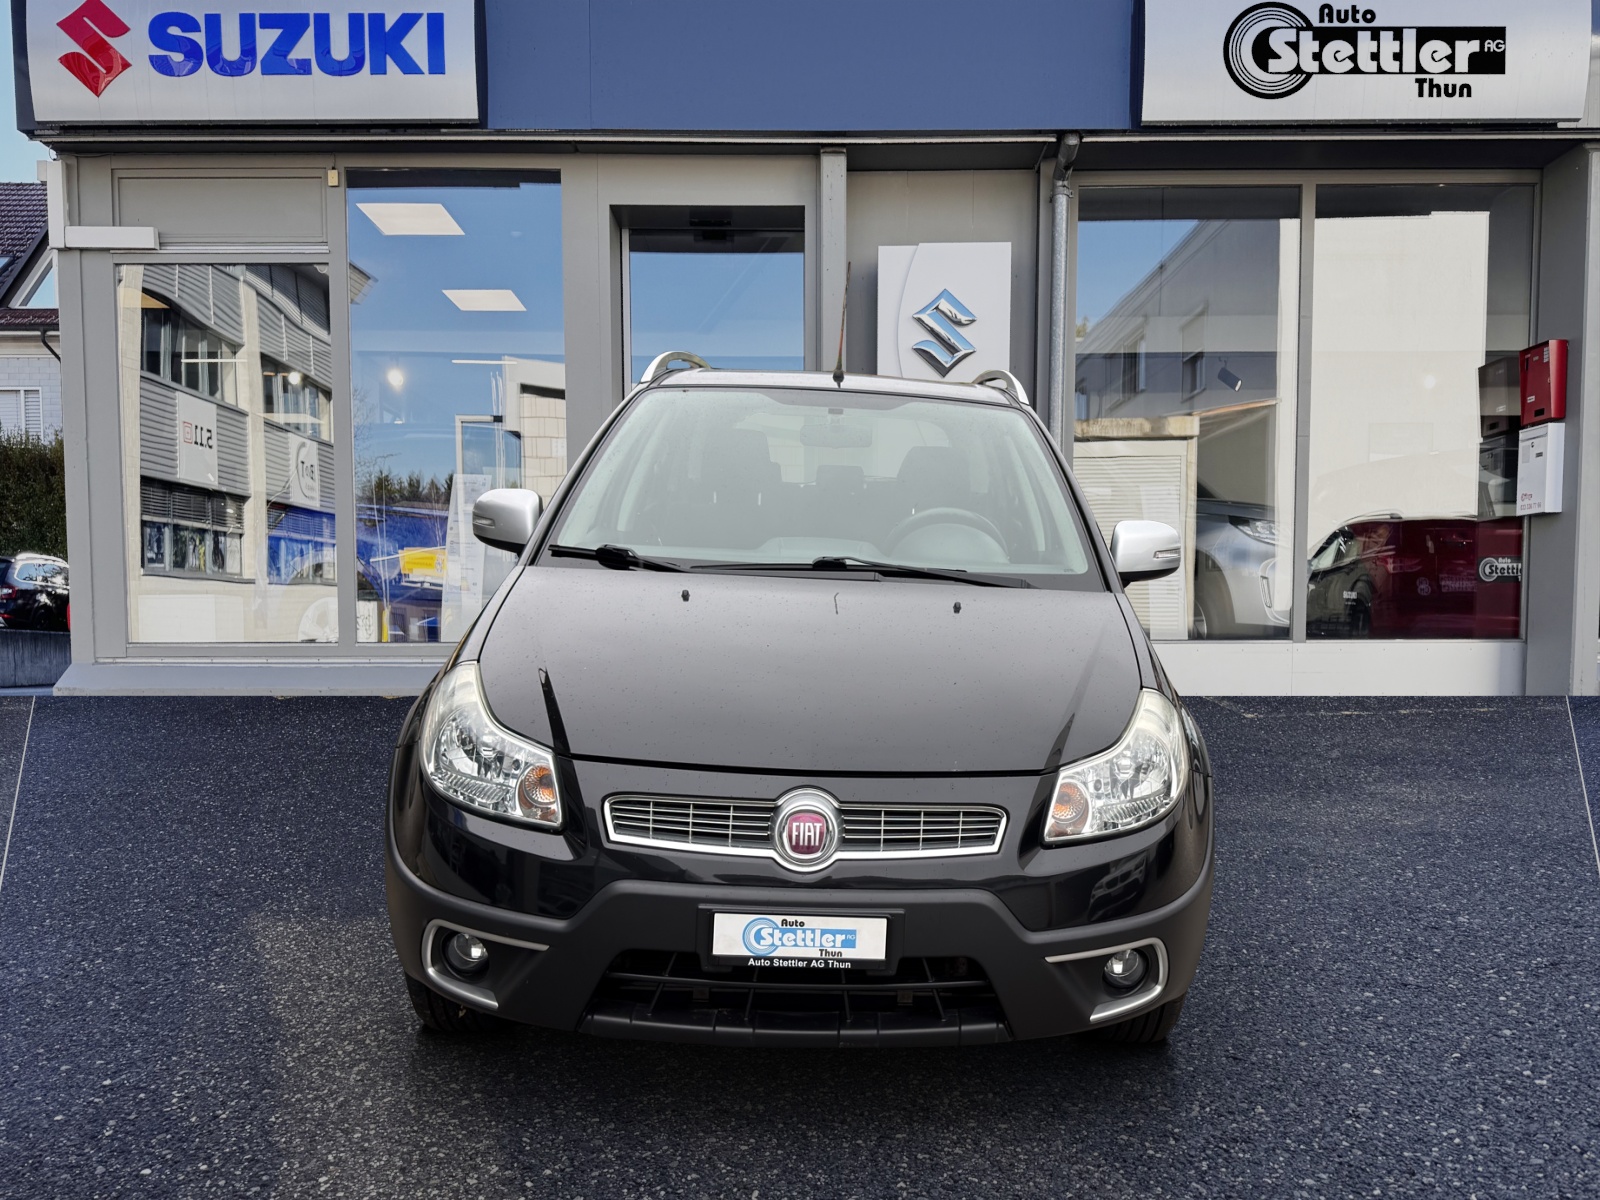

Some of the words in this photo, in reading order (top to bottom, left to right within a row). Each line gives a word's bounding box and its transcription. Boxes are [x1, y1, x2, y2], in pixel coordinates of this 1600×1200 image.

[1318, 3, 1376, 24] Auto
[148, 11, 446, 77] SUZUKI
[1268, 28, 1480, 73] Stettler
[1484, 39, 1505, 53] AG
[1415, 78, 1472, 98] Thun
[791, 822, 823, 846] FIAT
[781, 918, 805, 928] Auto
[759, 927, 846, 948] Stettler
[748, 958, 771, 967] Auto
[773, 958, 807, 968] Stettler
[810, 959, 825, 968] AG
[827, 959, 851, 969] Thun
[818, 949, 843, 958] Thun
